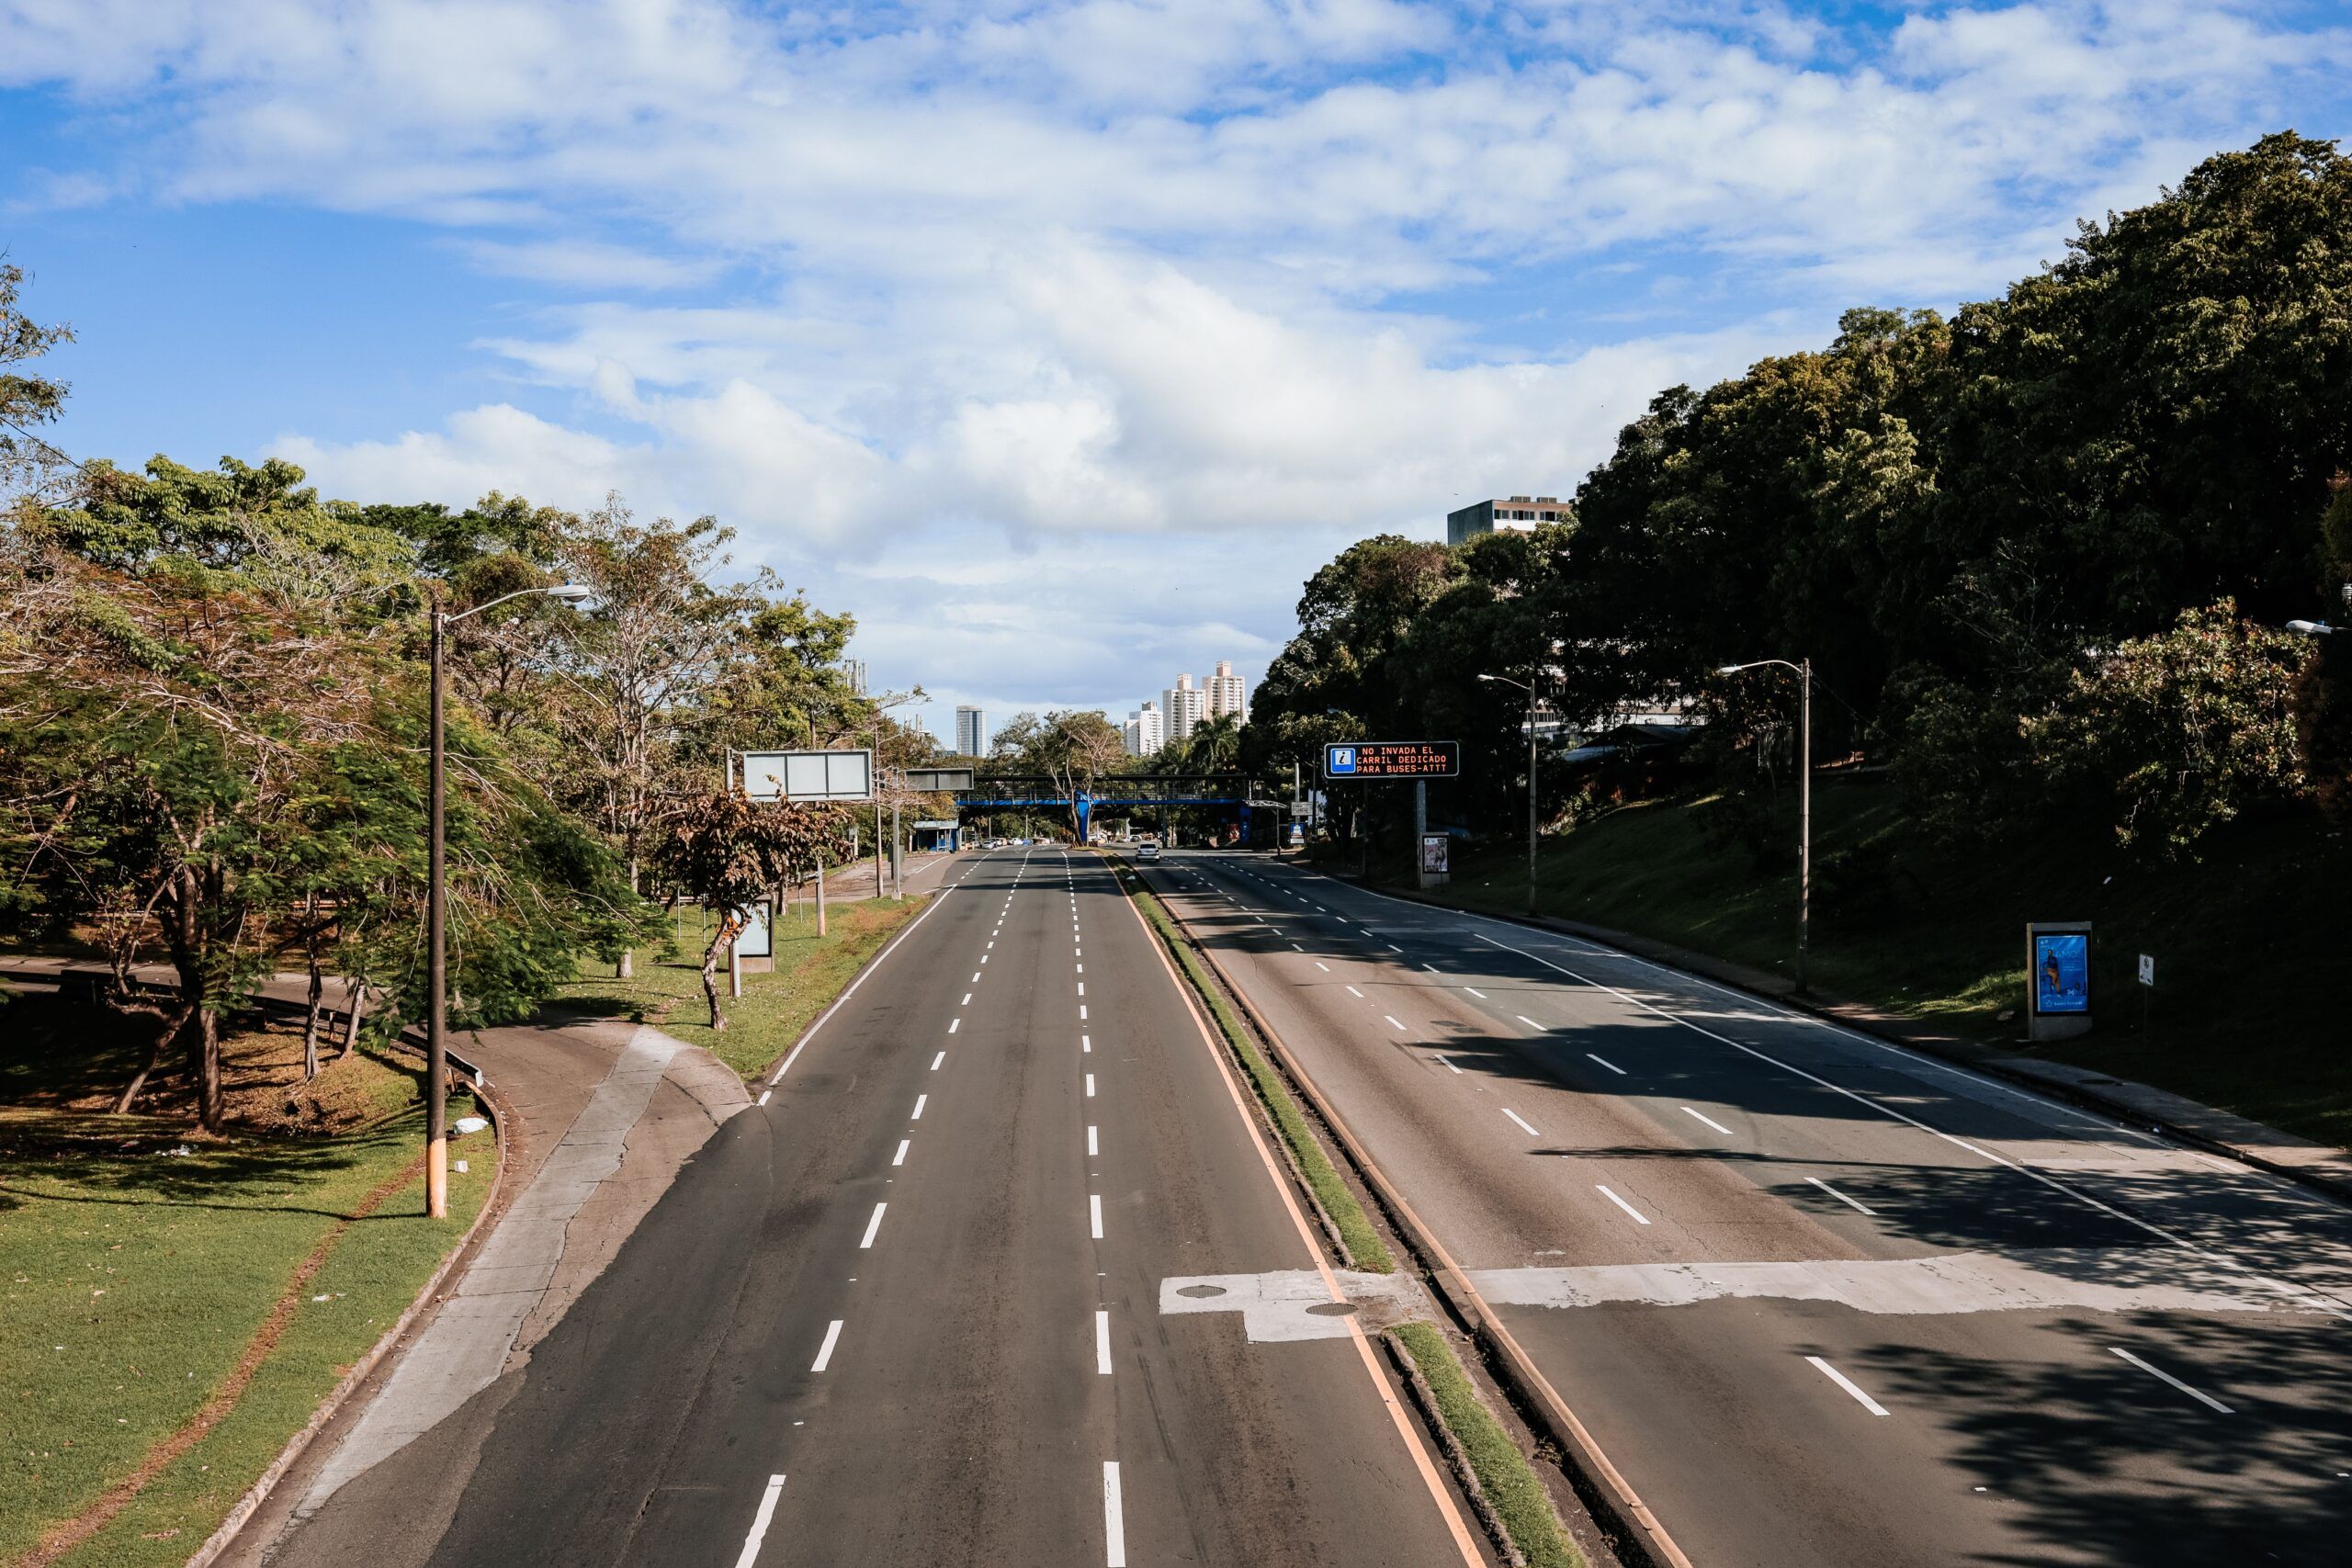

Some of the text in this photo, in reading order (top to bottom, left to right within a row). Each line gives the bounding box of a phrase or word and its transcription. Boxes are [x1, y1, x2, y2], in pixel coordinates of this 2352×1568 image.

[1362, 746, 1434, 755] NO INVADA EL
[1356, 755, 1447, 764] CARRIL DEDICADO
[1356, 763, 1447, 773] PARA BUSES-ATTT
